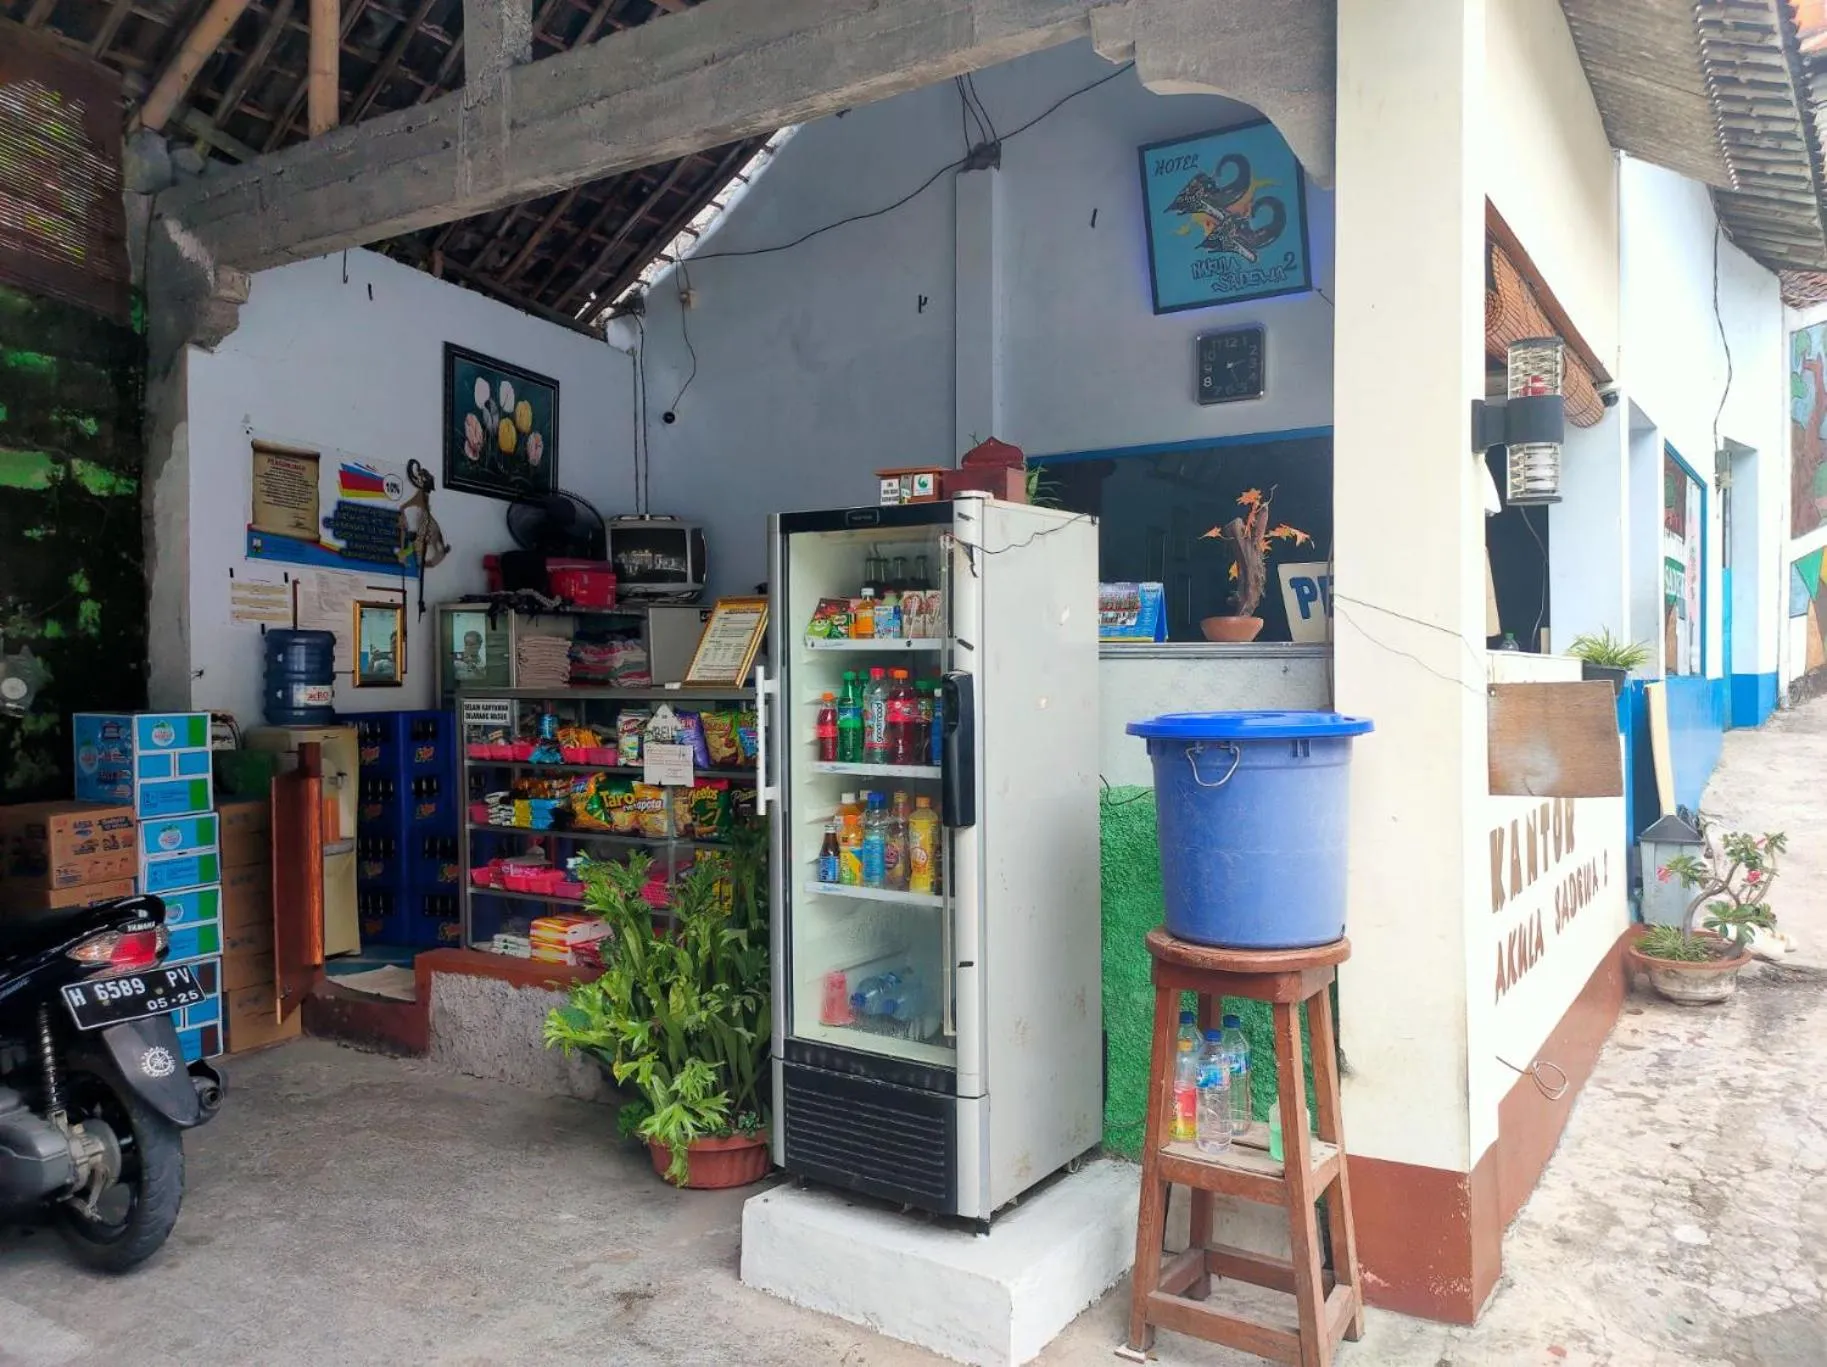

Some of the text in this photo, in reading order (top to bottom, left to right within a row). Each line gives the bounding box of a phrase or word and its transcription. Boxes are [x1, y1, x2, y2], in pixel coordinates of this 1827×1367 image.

[1153, 153, 1200, 177] HOTEL
[1284, 251, 1297, 270] 2
[1203, 376, 1212, 387] 8
[599, 790, 635, 808] Taro
[1489, 798, 1575, 914] KANTOR
[127, 921, 156, 932] YAMAHA
[68, 967, 191, 1007] H 6589 PV
